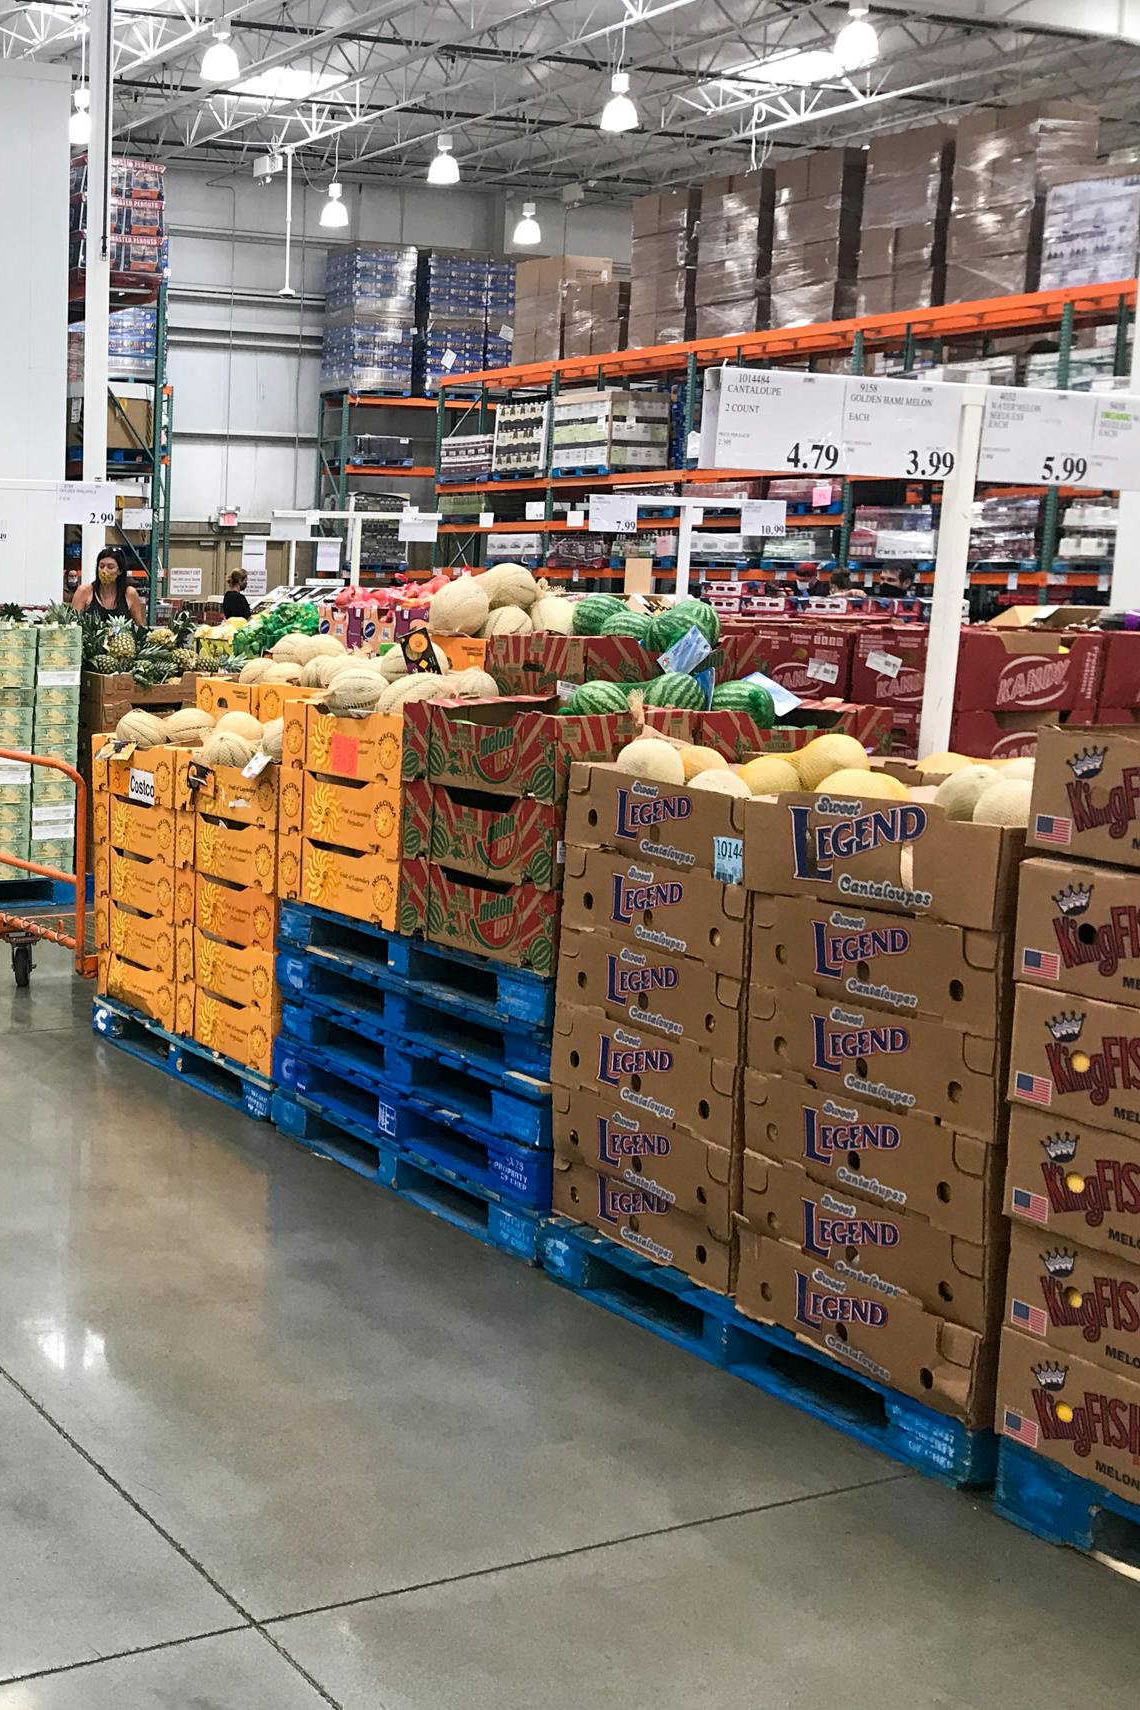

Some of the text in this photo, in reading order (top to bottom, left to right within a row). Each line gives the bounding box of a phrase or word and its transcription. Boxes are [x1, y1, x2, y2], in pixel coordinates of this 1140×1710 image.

[727, 385, 781, 396] CANTALOUPE
[738, 373, 770, 384] 1014484
[860, 383, 878, 393] 9158
[725, 403, 760, 414] 2 COUNT
[850, 393, 933, 407] GOLDEN HAMI MELON
[848, 412, 870, 422] EACH
[786, 442, 839, 470] 4.79
[906, 449, 955, 477] 3.99
[1041, 456, 1088, 483] 5.99
[89, 512, 114, 524] 2.99
[616, 520, 636, 532] 7.99
[760, 525, 785, 535] 10.99
[996, 659, 1071, 706] KANDY
[480, 726, 514, 752] melon
[494, 753, 510, 772] UP!
[130, 775, 155, 798] Costco
[614, 788, 693, 840] LEGEND
[815, 794, 862, 817] Sweet
[487, 813, 516, 845] melon
[496, 839, 515, 858] UP!
[640, 839, 696, 865] Cantaloupes
[788, 804, 928, 883] LEGEND
[611, 873, 684, 926] LEGEND
[838, 873, 932, 907] Cantaloupes
[480, 895, 514, 922] melon
[830, 911, 866, 930] Sweet
[494, 918, 513, 937] UP!
[635, 925, 687, 952] Cantaloupes
[811, 920, 910, 979] LEGEND
[606, 953, 679, 1006] LEGEND
[846, 978, 918, 1007] Cantaloupes
[629, 1006, 683, 1035] Cantaloupes
[830, 1007, 864, 1026] Sweet
[811, 1013, 910, 1073] LEGEND
[596, 1033, 674, 1087] LEGEND
[620, 1087, 676, 1119] Cantaloupes
[844, 1073, 916, 1106] Cantaloupes
[823, 1100, 859, 1123] Sweet
[597, 1115, 672, 1168] LEGEND
[802, 1105, 901, 1167] LEGEND
[597, 1172, 670, 1226] LEGEND
[623, 1169, 676, 1203] Cantaloupes
[836, 1166, 907, 1204] Cantaloupes
[821, 1194, 857, 1217] Sweet
[800, 1196, 900, 1259] LEGEND
[620, 1226, 674, 1261] Cantaloupes
[812, 1268, 847, 1293] Sweet
[794, 1270, 890, 1330] LEGEND
[825, 1333, 892, 1382] Cantaloupes
